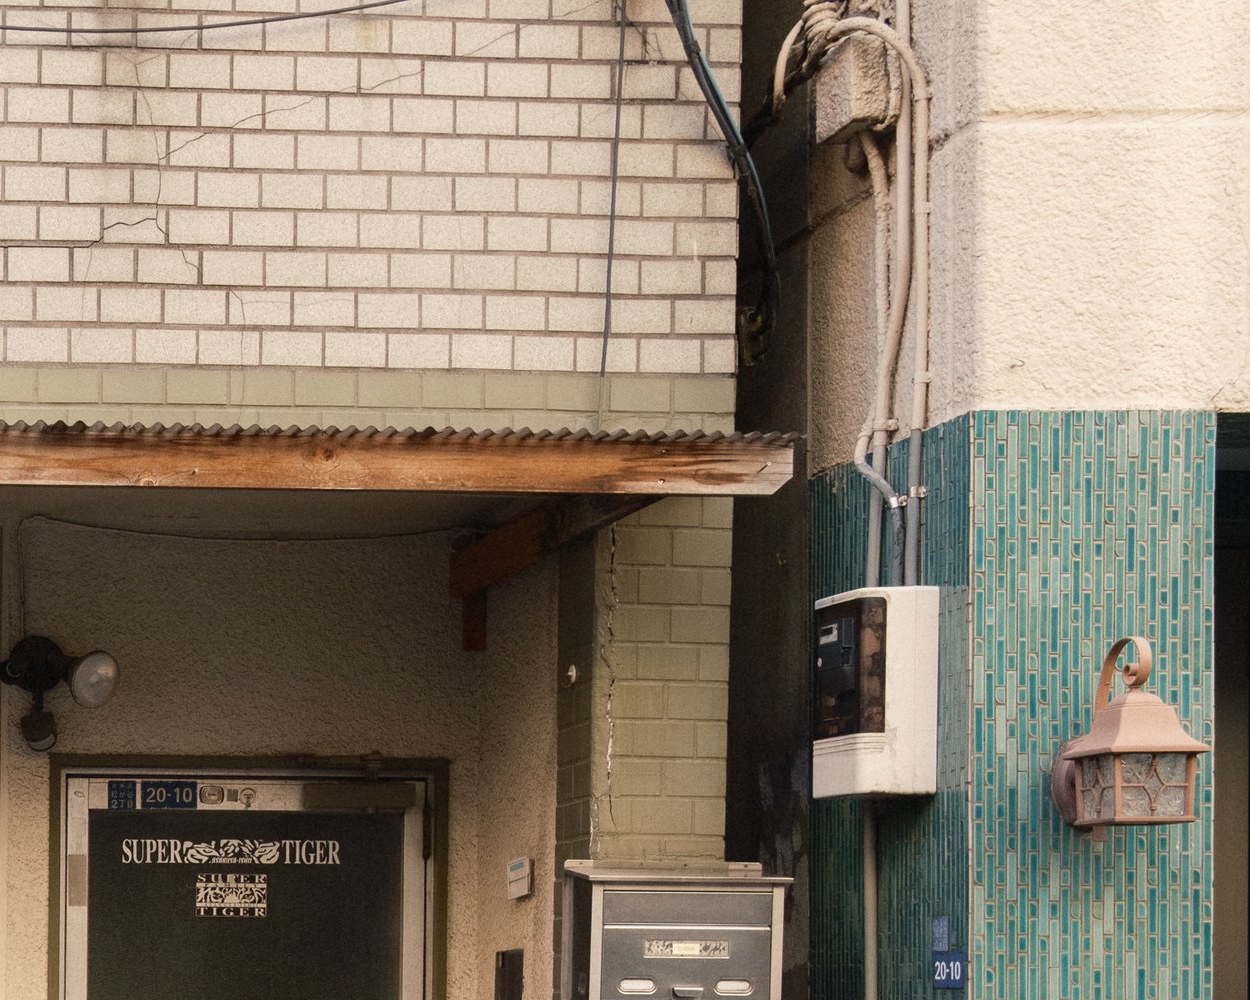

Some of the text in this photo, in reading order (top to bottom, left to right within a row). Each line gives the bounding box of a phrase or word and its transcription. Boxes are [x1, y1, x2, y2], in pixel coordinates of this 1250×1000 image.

[146, 787, 193, 803] 20-10
[122, 838, 341, 865] SUPER TIGER
[197, 907, 266, 917] TIGER
[934, 961, 961, 980] 20-10
